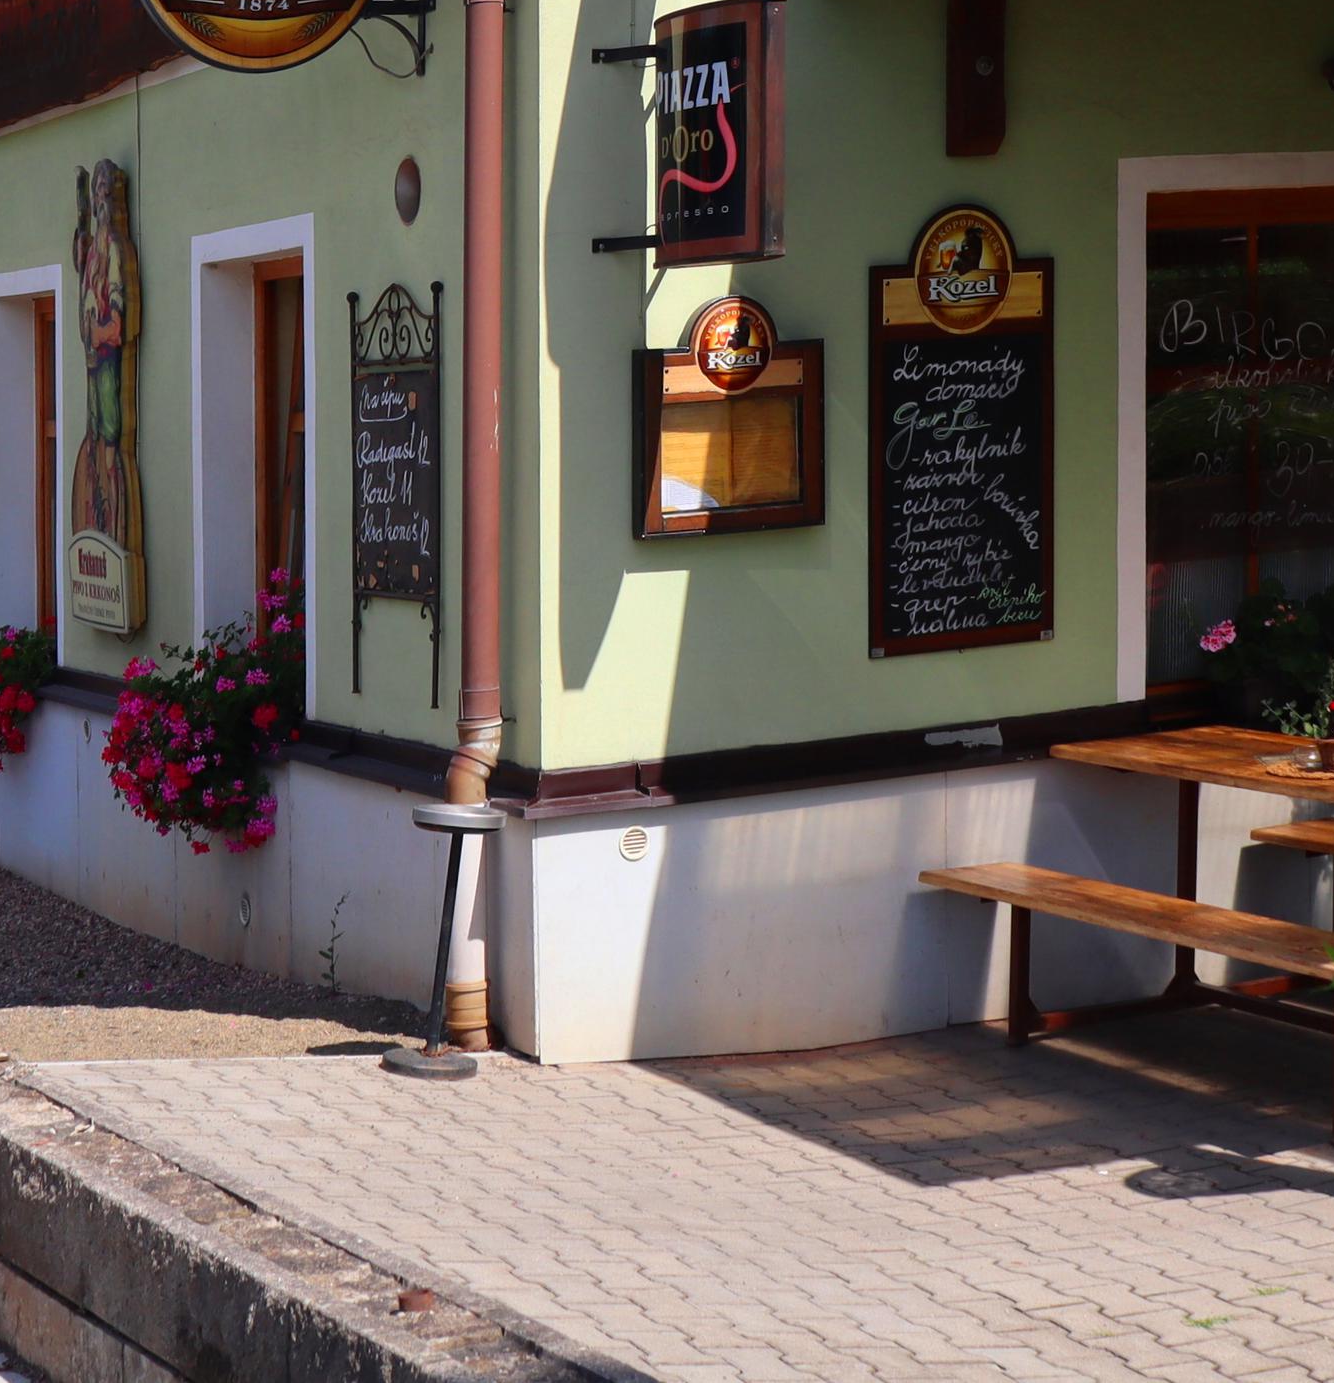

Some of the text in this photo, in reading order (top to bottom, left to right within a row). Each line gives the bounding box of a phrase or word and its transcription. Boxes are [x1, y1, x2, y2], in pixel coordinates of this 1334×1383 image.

[655, 59, 731, 117] PIAZZA
[662, 124, 714, 163] D'Oro
[928, 275, 999, 302] Kozel
[707, 351, 763, 371] Kozel
[893, 344, 1025, 393] Limonády
[418, 429, 431, 466] 12
[401, 470, 413, 507] 11
[419, 516, 431, 556] 12
